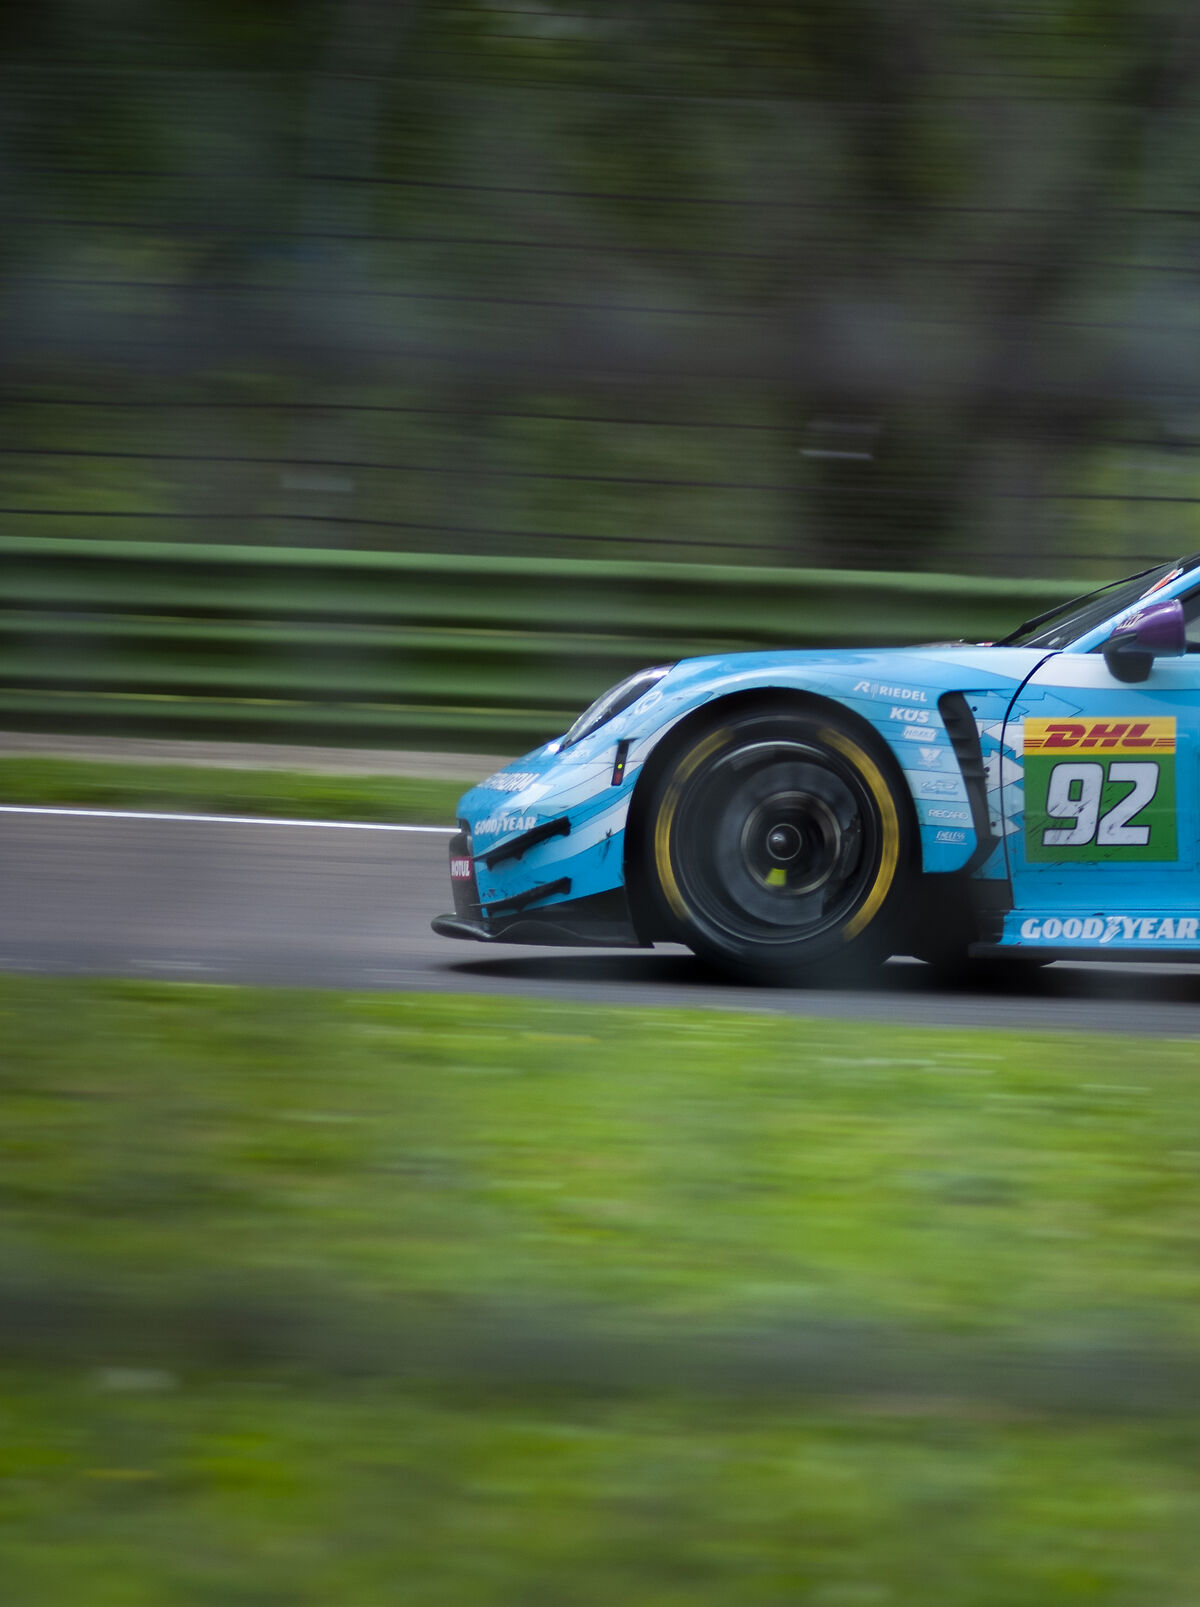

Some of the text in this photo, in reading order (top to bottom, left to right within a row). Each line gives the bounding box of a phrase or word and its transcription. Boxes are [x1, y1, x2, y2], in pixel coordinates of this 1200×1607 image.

[879, 686, 928, 702] RIEDEL
[1043, 723, 1156, 748] DHL
[1041, 761, 1160, 847] 92
[1020, 916, 1200, 943] GOODYEAR
